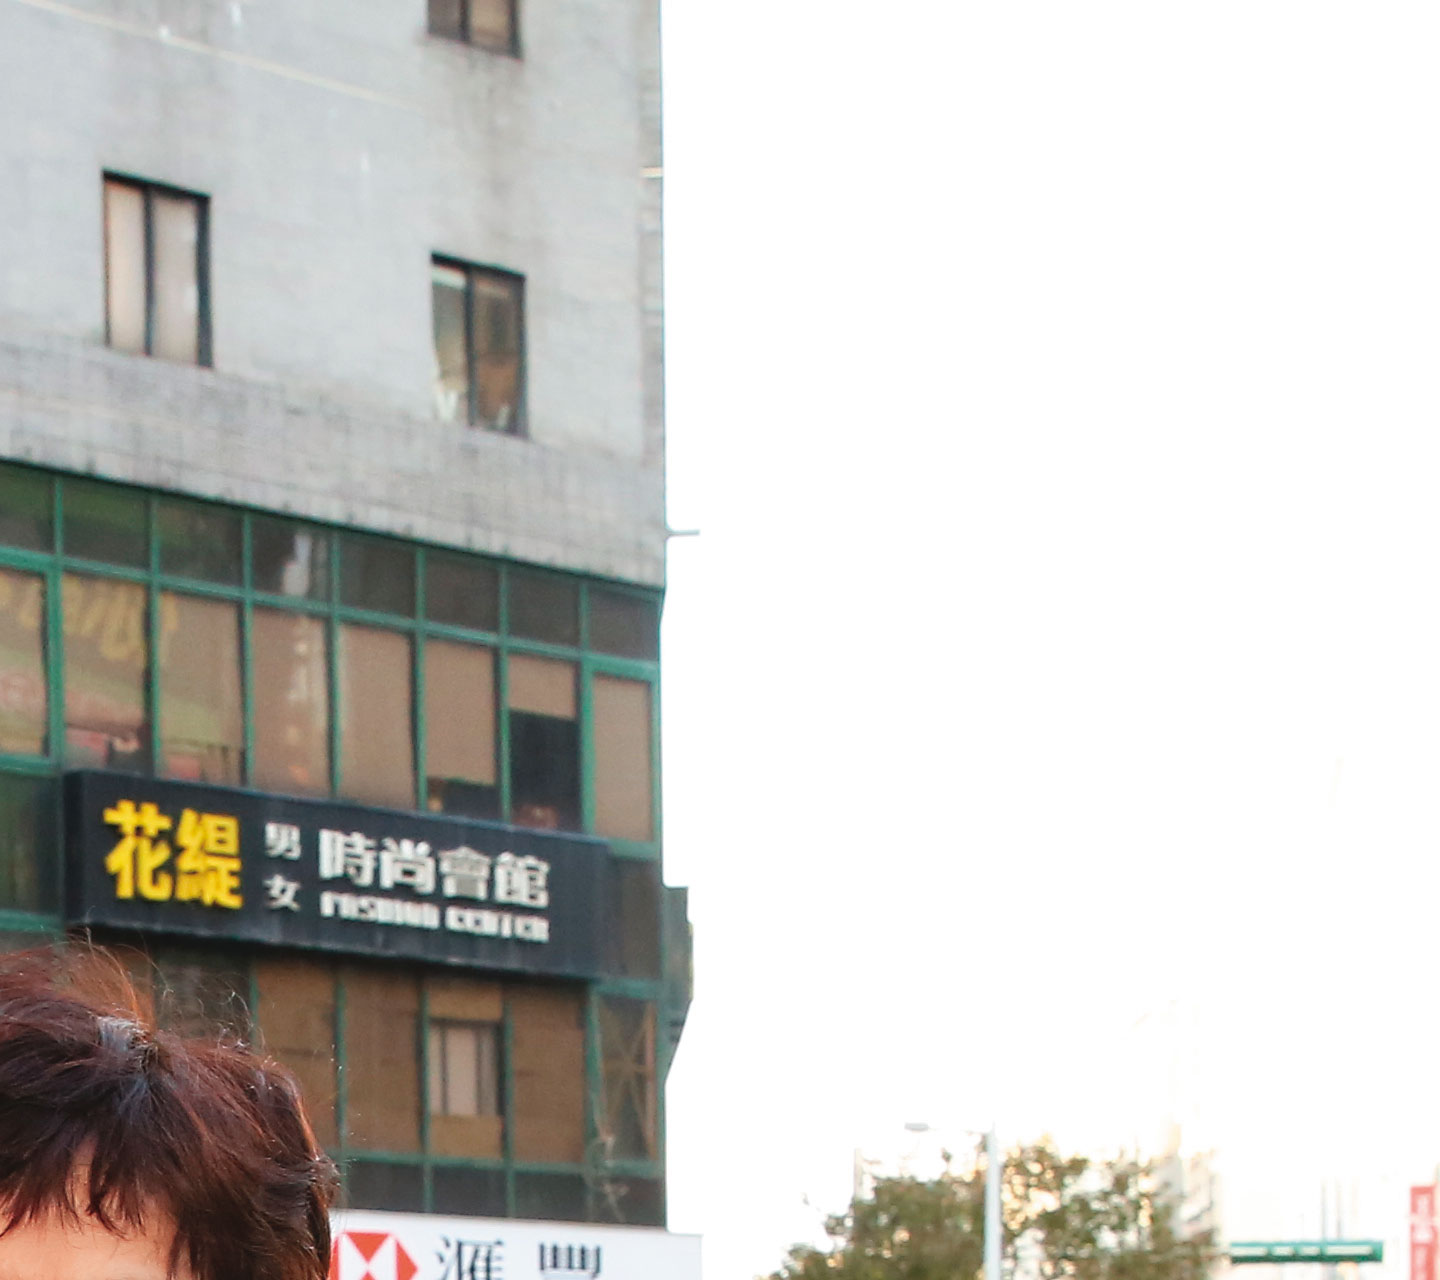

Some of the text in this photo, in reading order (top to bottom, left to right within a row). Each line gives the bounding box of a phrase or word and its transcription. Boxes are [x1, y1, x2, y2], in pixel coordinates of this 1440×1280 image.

[103, 799, 243, 910] 花緹
[319, 828, 551, 909] 時尚會館
